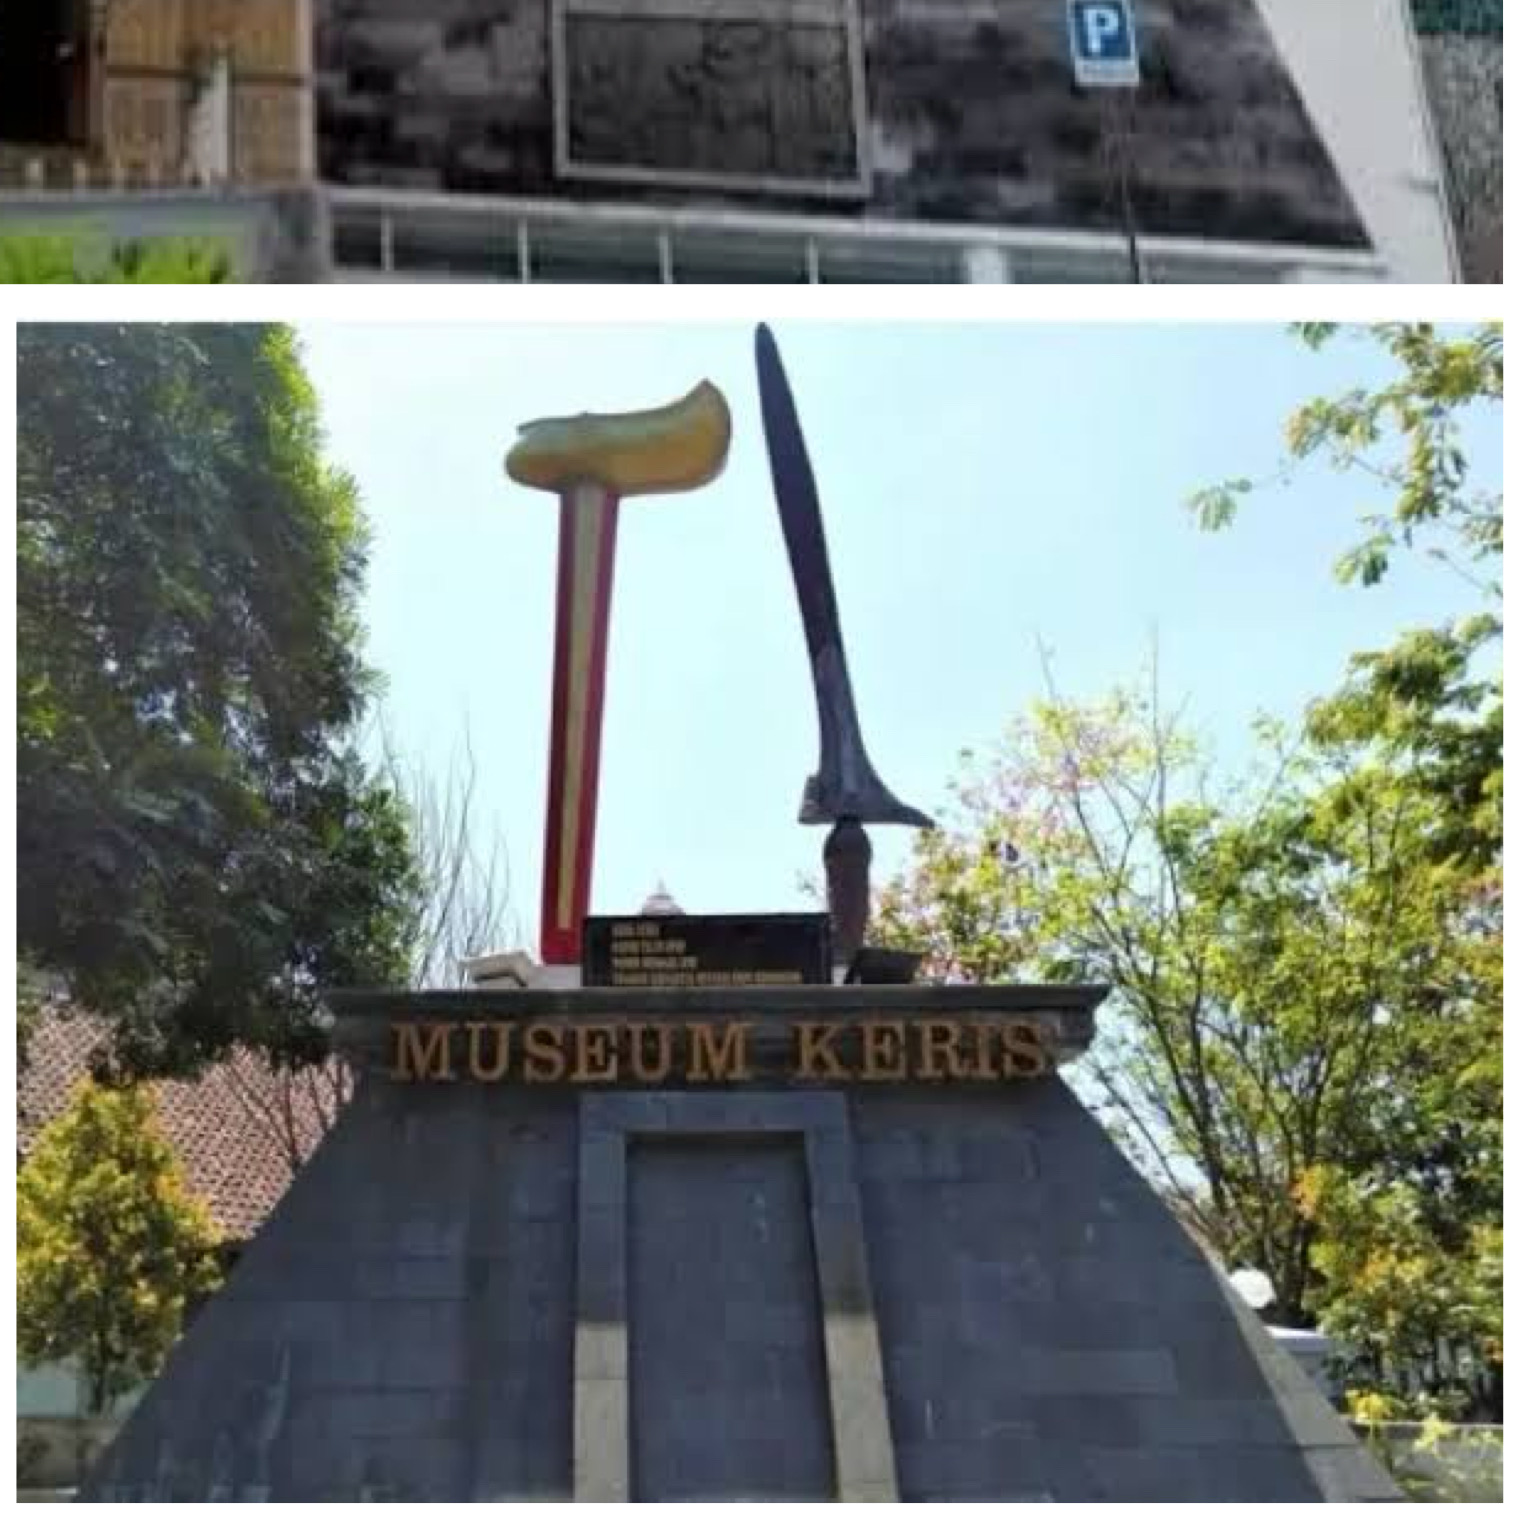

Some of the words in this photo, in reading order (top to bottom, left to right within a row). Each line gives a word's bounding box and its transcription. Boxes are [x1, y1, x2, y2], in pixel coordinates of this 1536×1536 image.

[1084, 9, 1119, 53] P
[391, 1020, 756, 1083] MUSEUM
[792, 1020, 1057, 1080] KERIS
